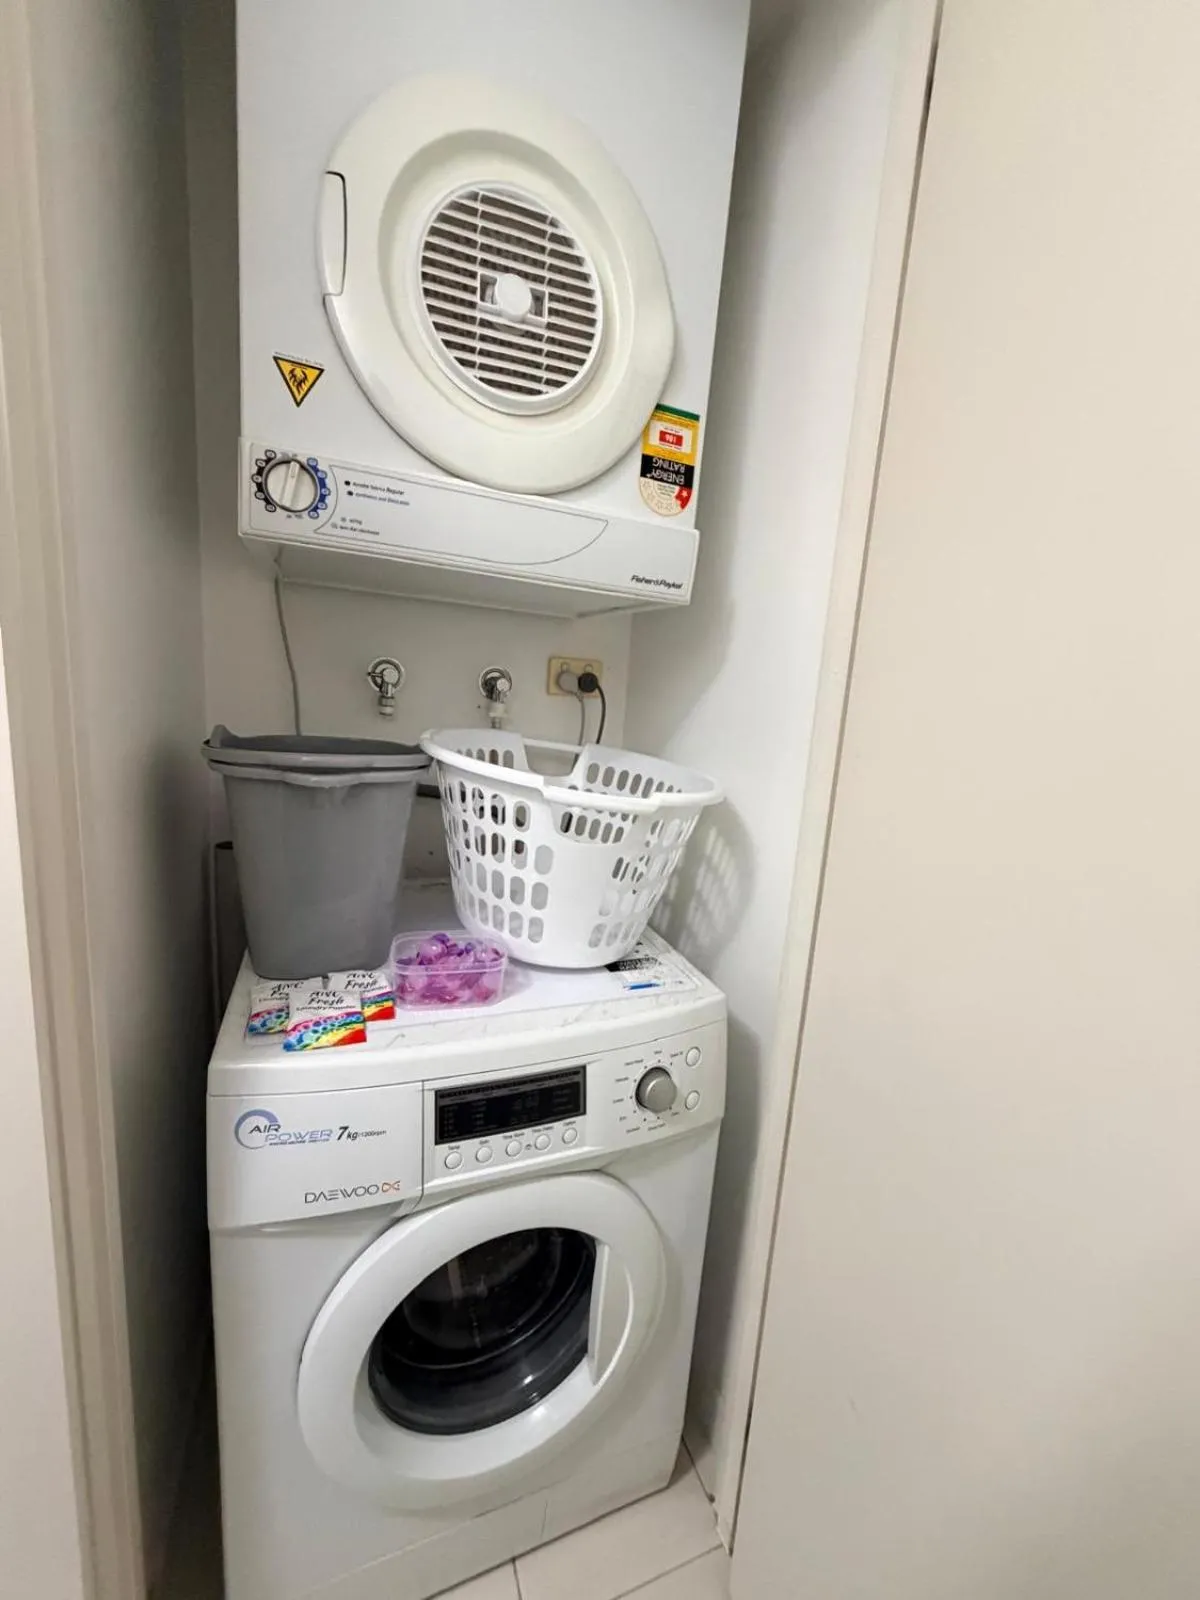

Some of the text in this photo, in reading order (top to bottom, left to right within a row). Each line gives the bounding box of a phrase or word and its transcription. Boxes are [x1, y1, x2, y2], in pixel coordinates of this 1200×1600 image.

[652, 457, 686, 474] RATING
[651, 468, 685, 485] ENERGY
[248, 1123, 281, 1135] AIR
[264, 1129, 334, 1142] POWER
[304, 1184, 380, 1204] DAEWOO
